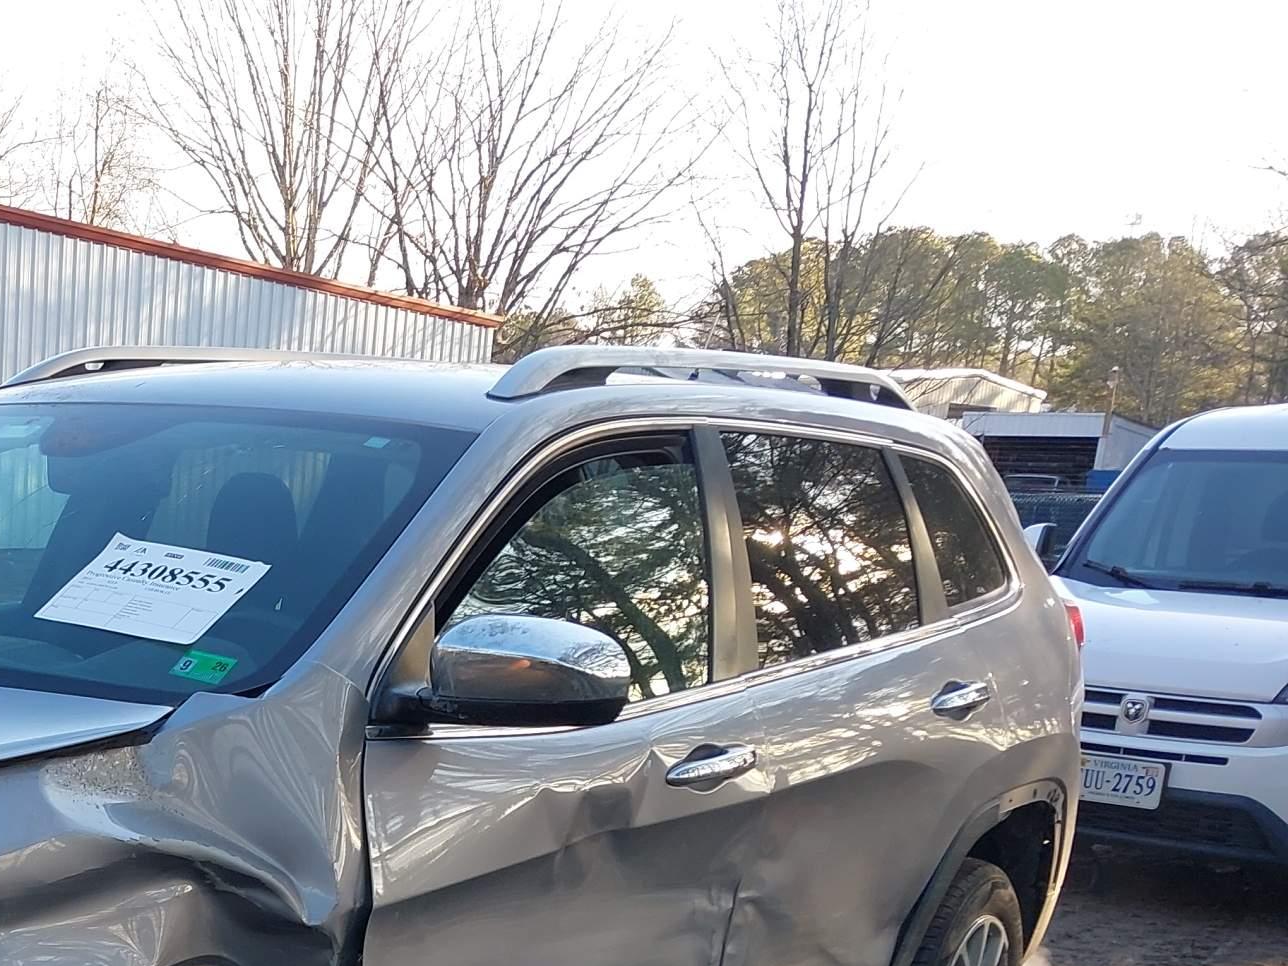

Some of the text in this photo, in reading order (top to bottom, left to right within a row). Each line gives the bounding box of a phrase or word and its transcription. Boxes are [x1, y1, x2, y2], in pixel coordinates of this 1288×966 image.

[104, 558, 233, 593] 44308555
[179, 659, 229, 673] 9 26
[1093, 759, 1138, 772] VIRGINIA
[1080, 767, 1156, 796] UU-2759
